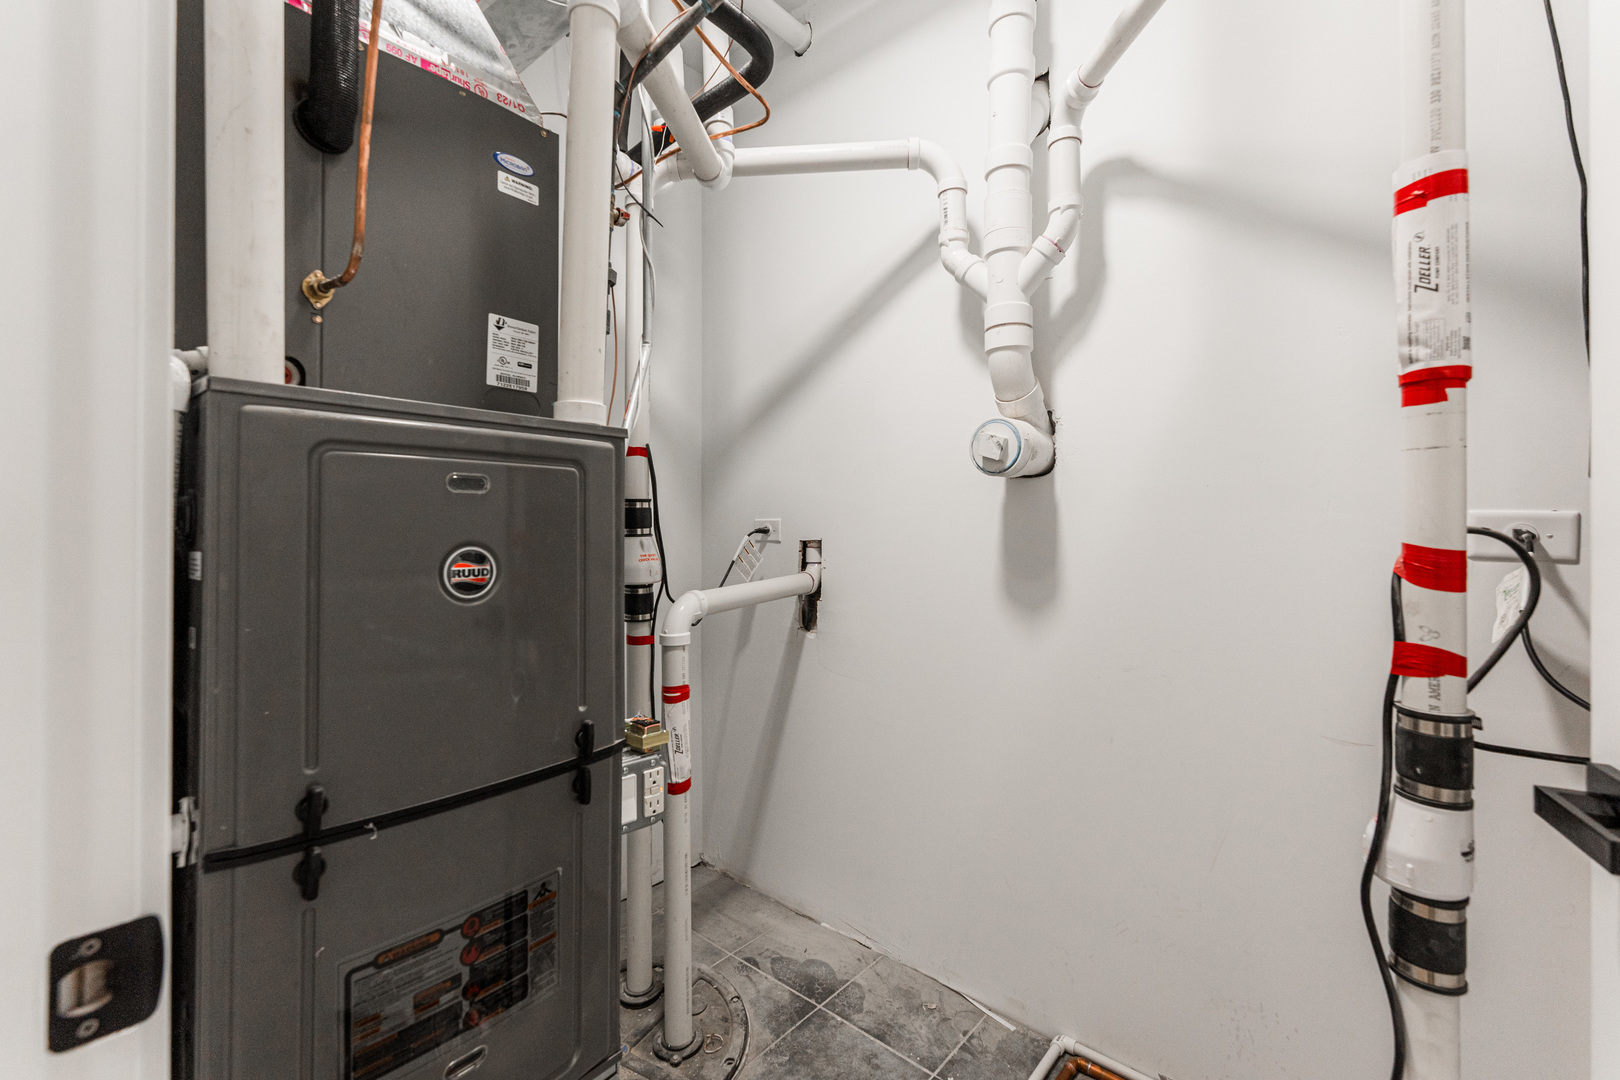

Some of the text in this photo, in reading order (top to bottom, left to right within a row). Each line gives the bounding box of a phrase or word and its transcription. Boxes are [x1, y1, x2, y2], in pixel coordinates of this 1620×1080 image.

[386, 43, 403, 57] 099
[405, 53, 418, 64] AF
[428, 63, 472, 91] Shurtape
[496, 92, 526, 113] Q1/23
[1413, 246, 1439, 293] ZOELLER
[452, 567, 490, 579] RUUD
[673, 733, 684, 755] ZOELLER
